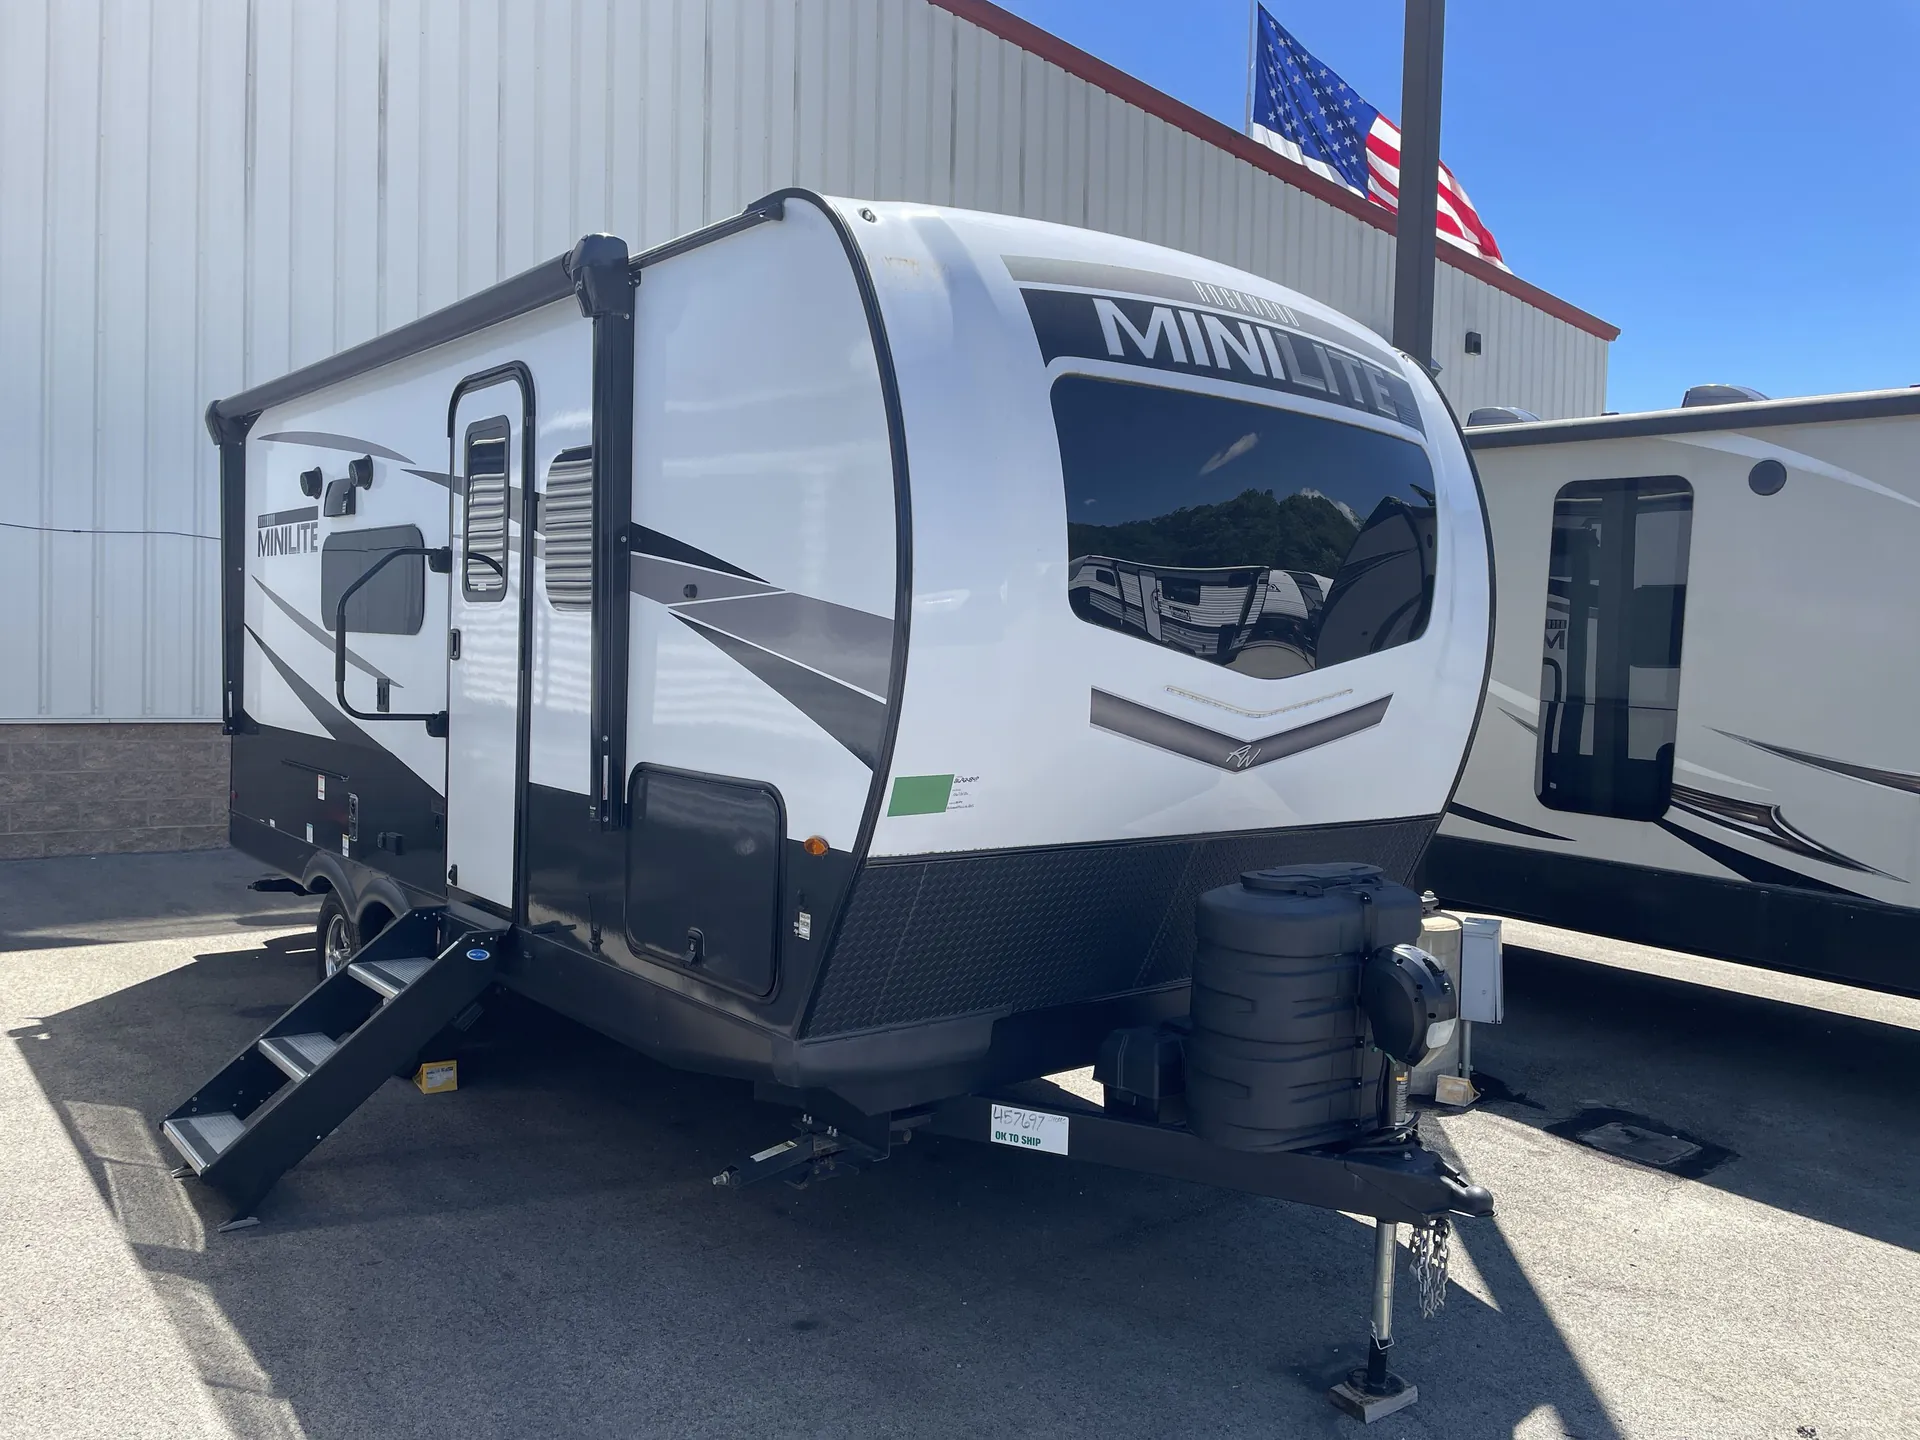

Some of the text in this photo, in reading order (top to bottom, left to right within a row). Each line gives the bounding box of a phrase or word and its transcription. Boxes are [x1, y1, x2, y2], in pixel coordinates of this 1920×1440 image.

[1192, 281, 1300, 327] ROCKWOOD
[257, 522, 319, 558] MINILITE
[993, 1105, 1046, 1131] 457697
[995, 1130, 1041, 1147] OK TO SHIP
